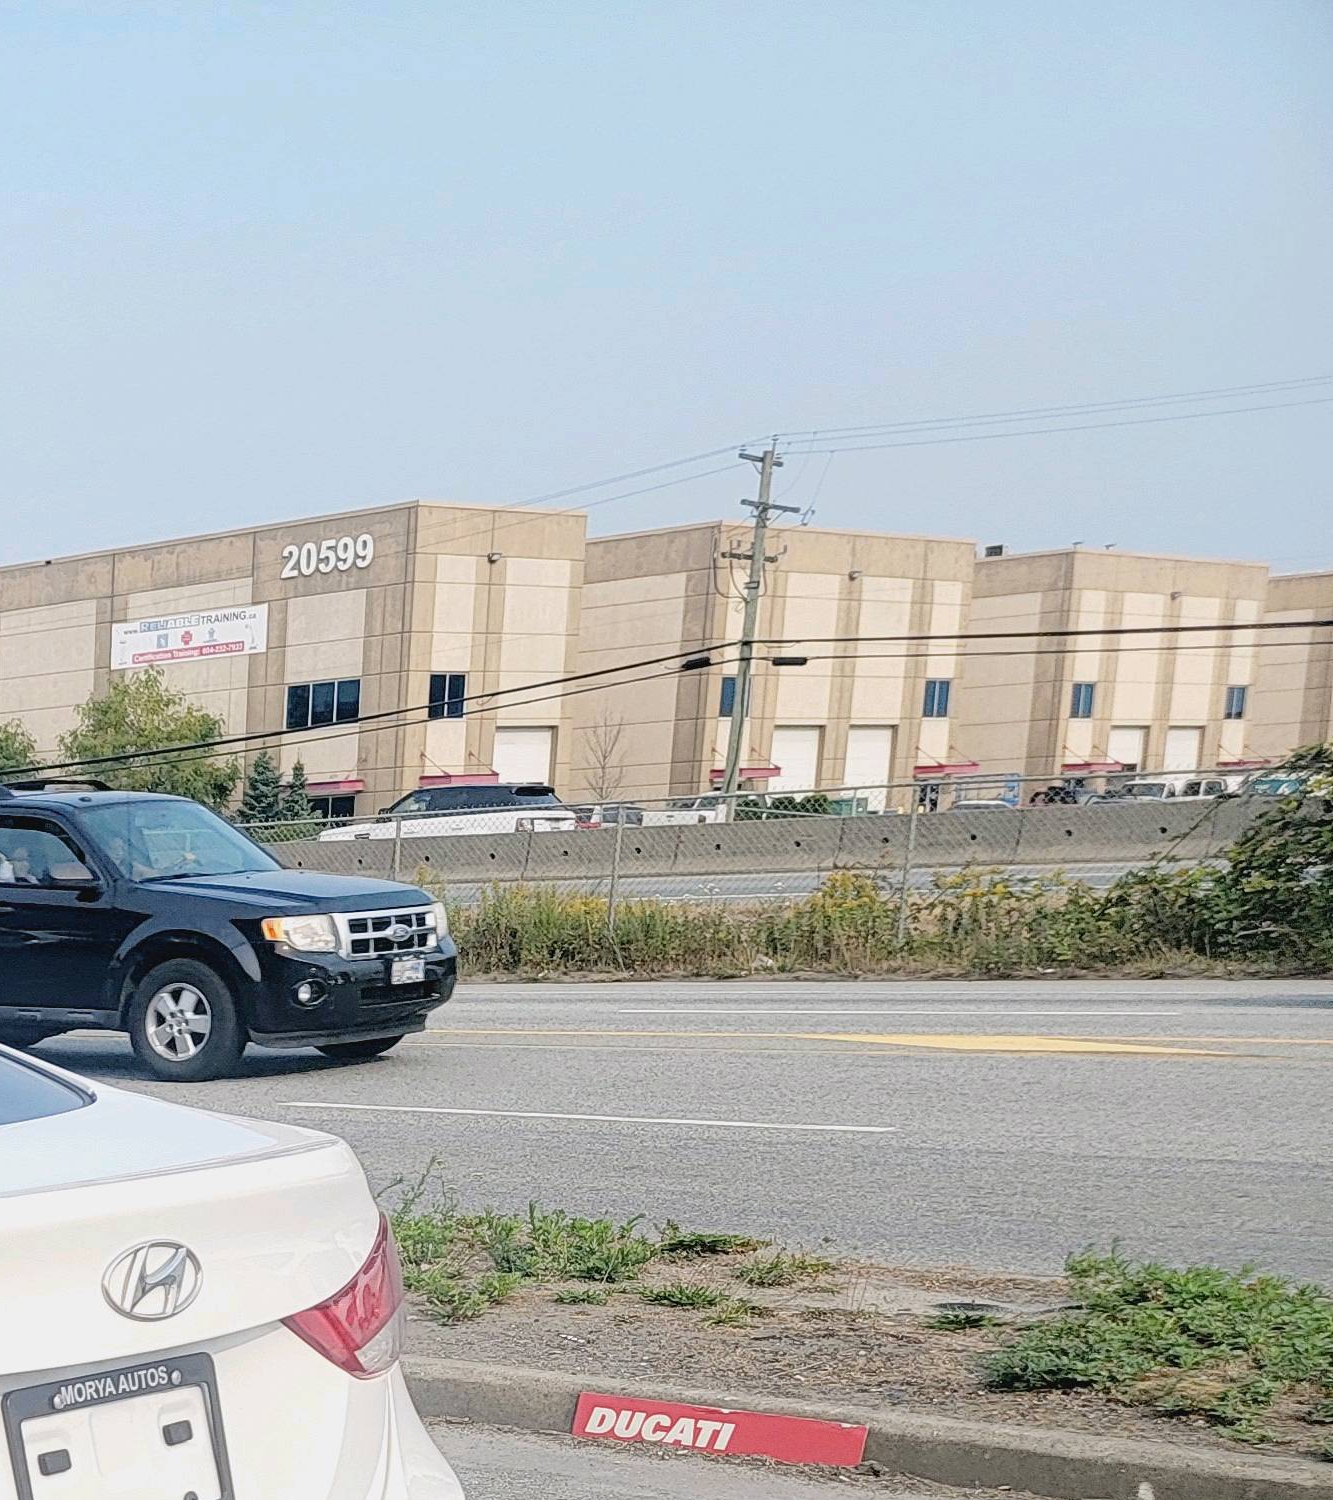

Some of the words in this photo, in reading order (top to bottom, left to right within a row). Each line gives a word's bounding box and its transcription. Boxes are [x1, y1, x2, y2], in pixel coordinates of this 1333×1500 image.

[279, 533, 374, 579] 20599
[60, 1378, 117, 1405] MORYA
[118, 1366, 168, 1394] AUTOS
[584, 1406, 737, 1451] DUCATI
